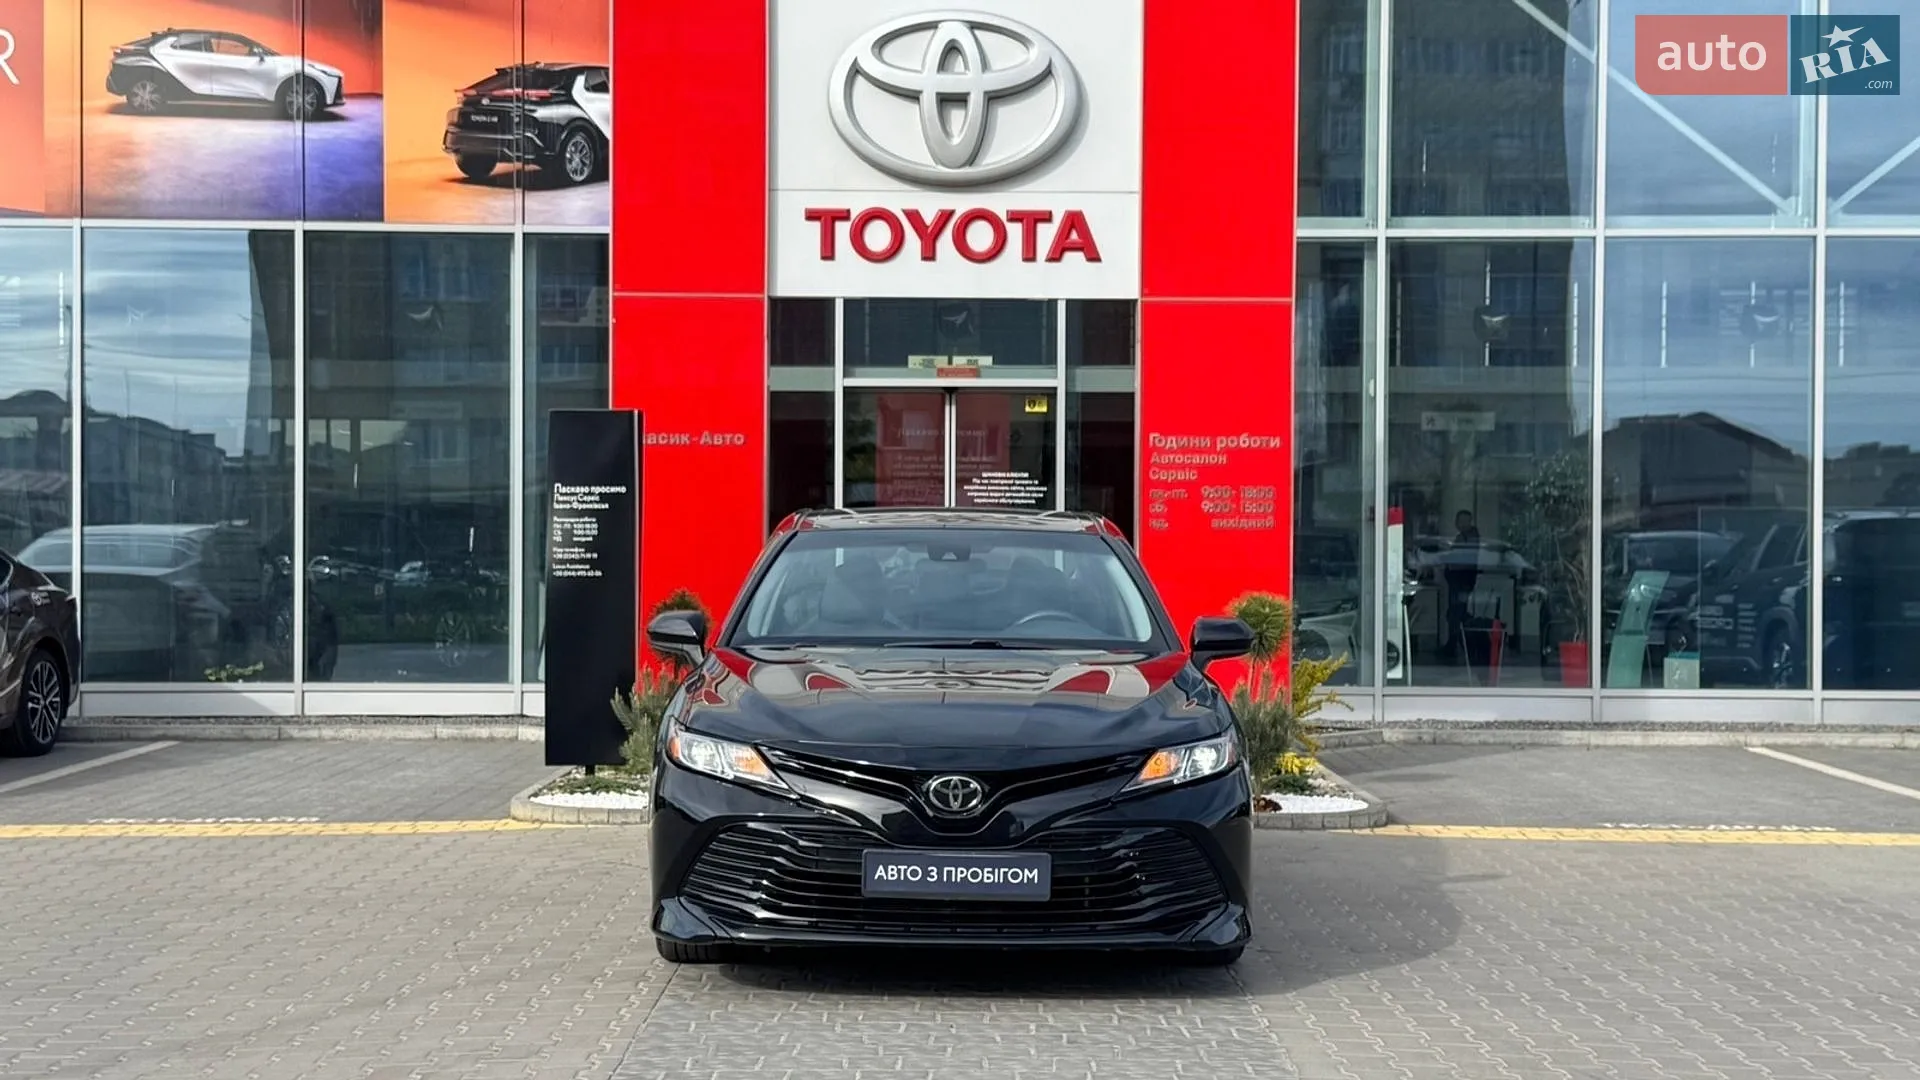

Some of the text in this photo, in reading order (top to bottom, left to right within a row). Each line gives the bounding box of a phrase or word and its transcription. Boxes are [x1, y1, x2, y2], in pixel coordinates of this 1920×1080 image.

[804, 206, 1102, 264] TOYOTA
[1149, 432, 1281, 451] Години роботи
[1151, 452, 1228, 465] Автосалон
[1149, 467, 1198, 482] Сервіс
[874, 865, 922, 881] АВТО
[943, 867, 1039, 884] ПРОБІГОМ
